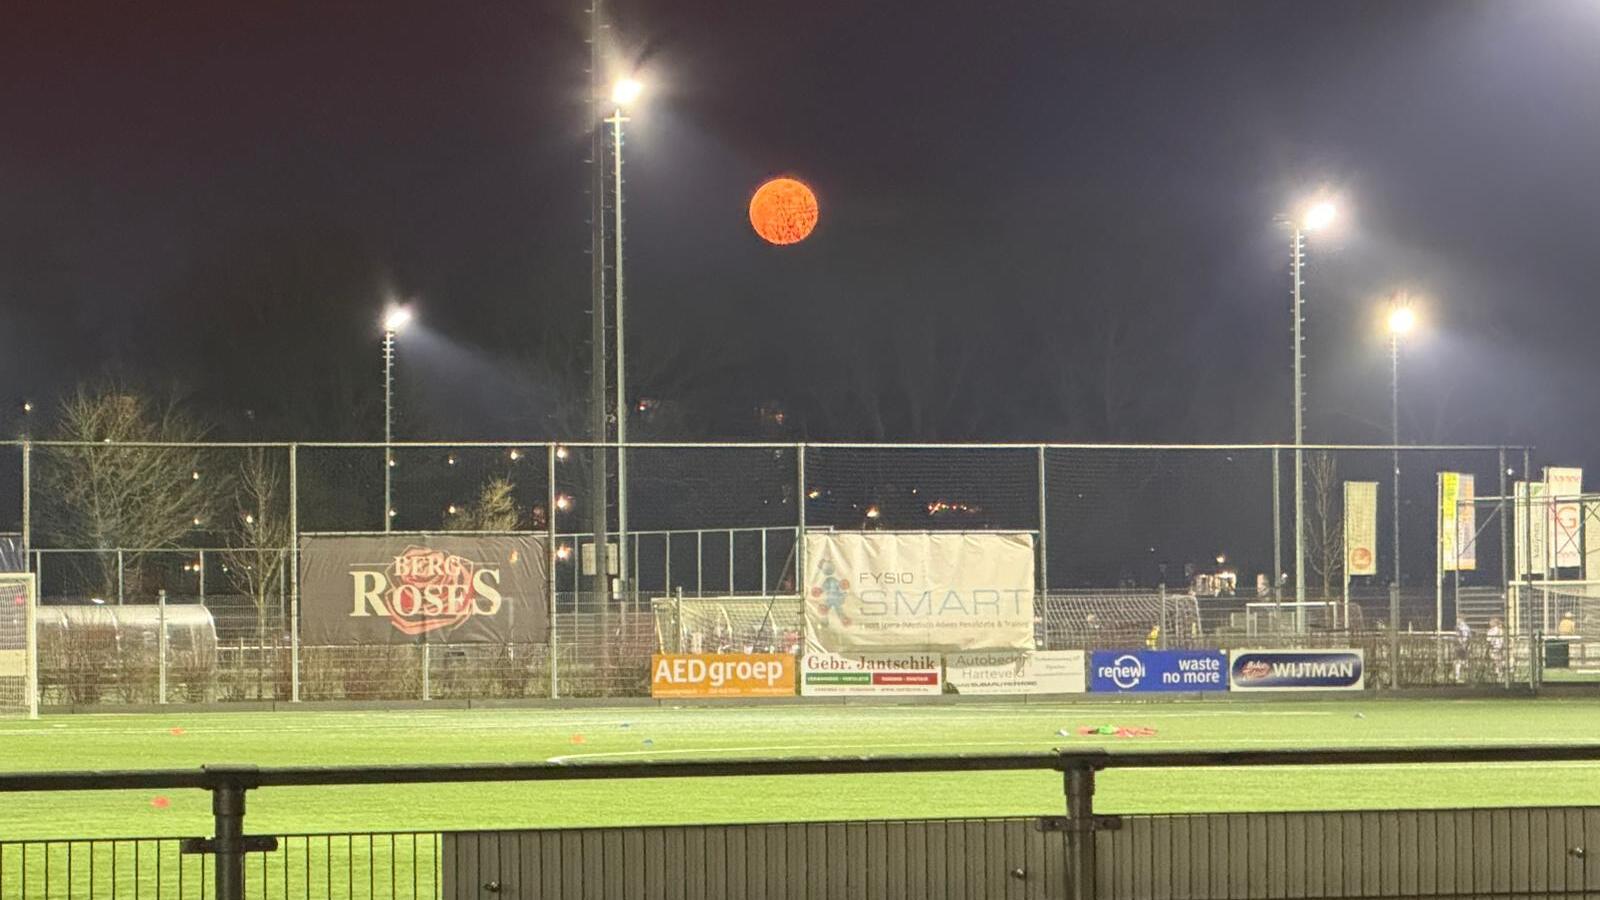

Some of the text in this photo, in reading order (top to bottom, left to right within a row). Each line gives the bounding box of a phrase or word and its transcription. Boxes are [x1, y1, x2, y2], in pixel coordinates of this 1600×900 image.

[393, 556, 462, 577] BERG
[859, 572, 915, 585] FYSIO
[349, 568, 502, 617] ROSES
[859, 588, 1031, 616] SMART
[807, 655, 935, 670] Gebr. Jantschik
[1179, 657, 1220, 671] waste
[1272, 662, 1354, 678] WIJTMAN
[1098, 663, 1146, 678] renewi
[1163, 671, 1220, 684] no more
